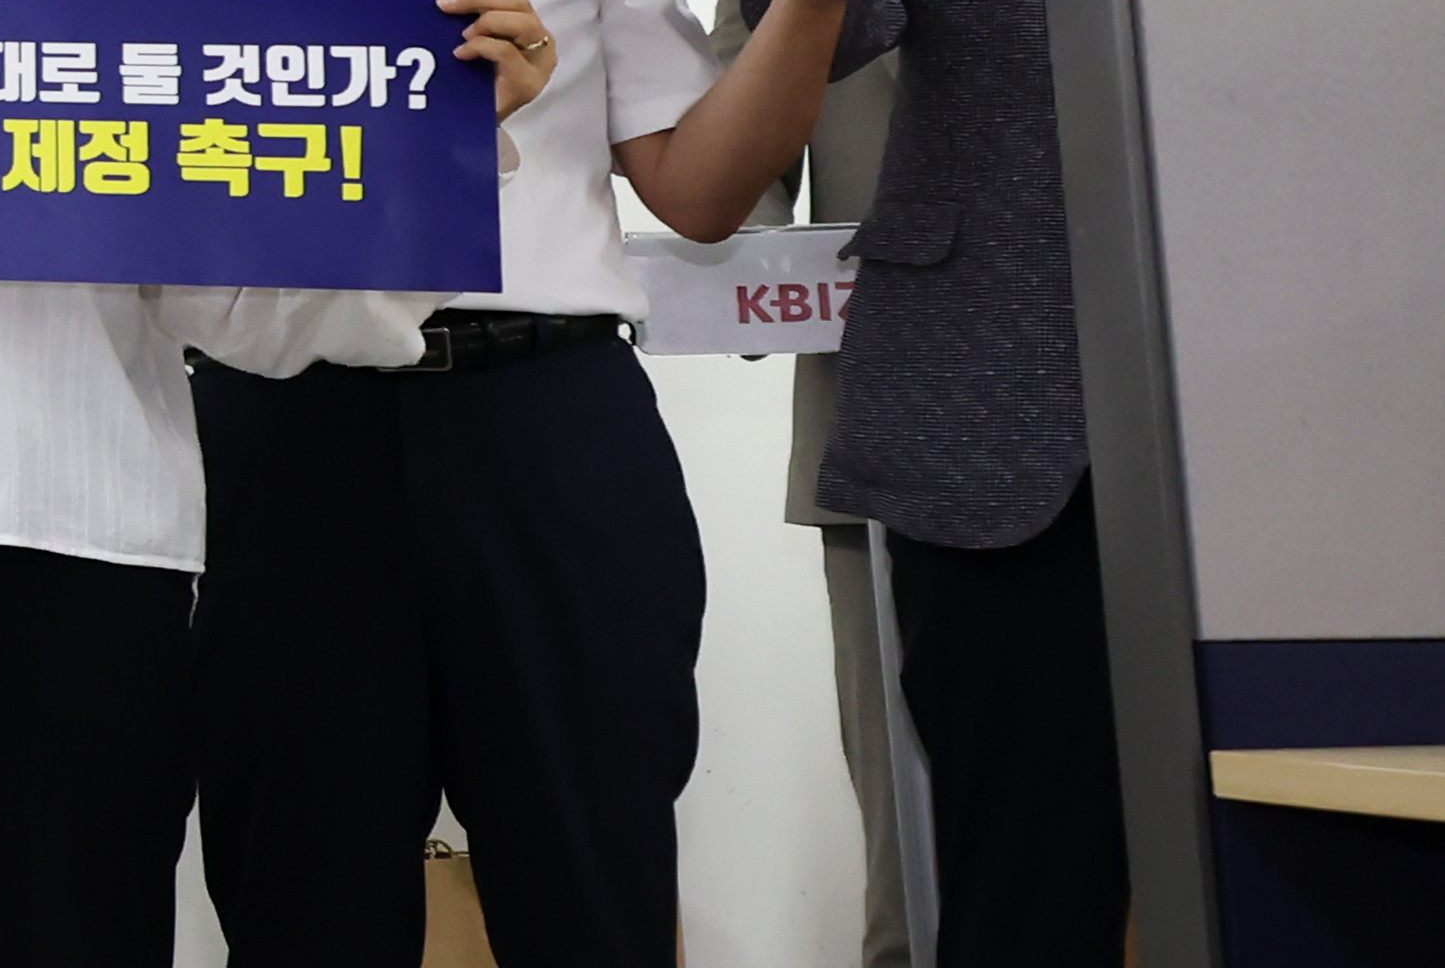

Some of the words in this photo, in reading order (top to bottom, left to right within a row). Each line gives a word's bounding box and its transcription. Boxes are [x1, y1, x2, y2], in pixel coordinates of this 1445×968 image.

[119, 43, 182, 105] 둘
[202, 44, 436, 110] 것인가?
[5, 120, 150, 195] 제정
[179, 118, 363, 201] 촉구!
